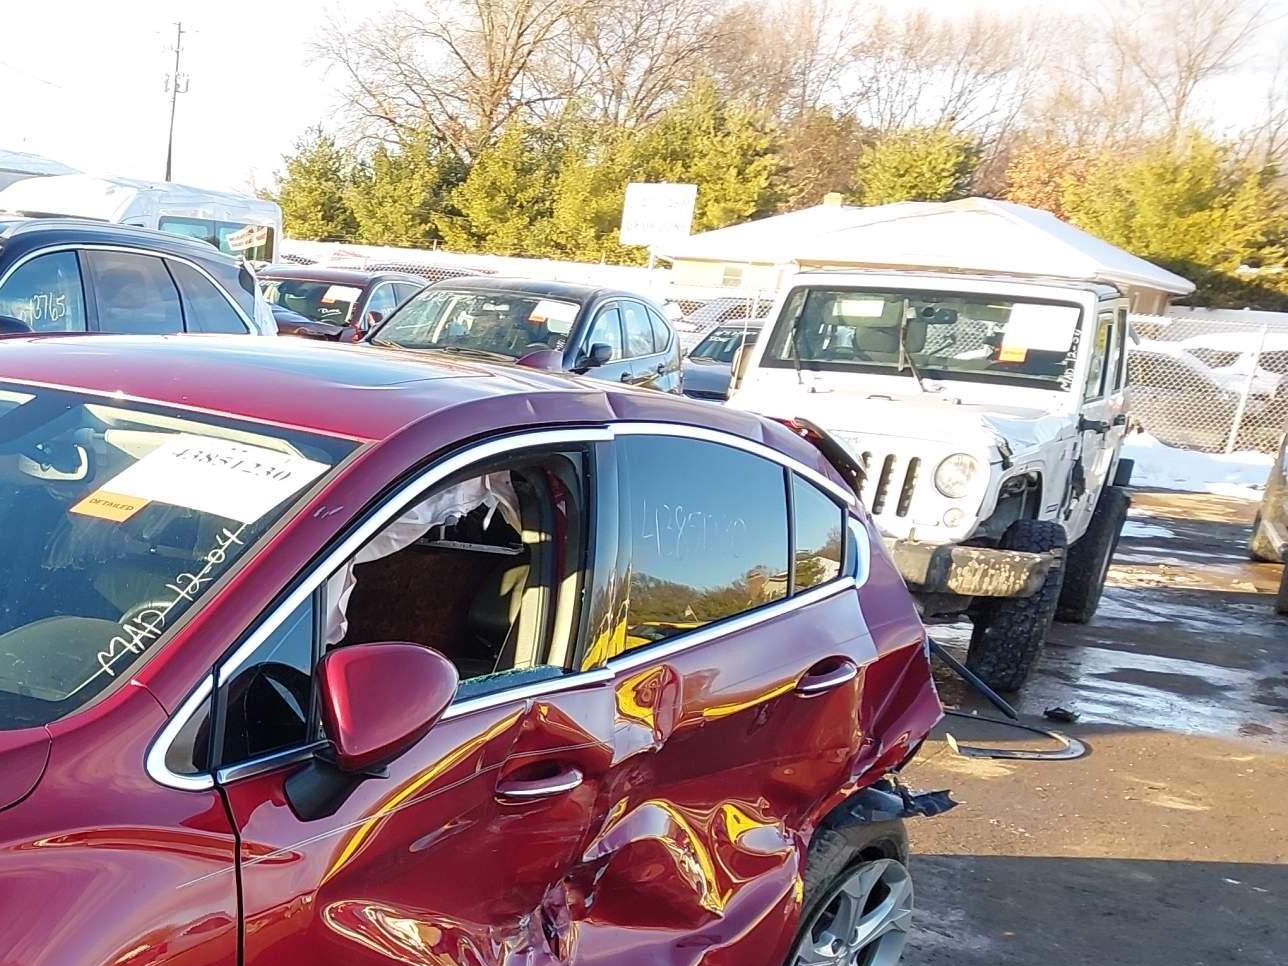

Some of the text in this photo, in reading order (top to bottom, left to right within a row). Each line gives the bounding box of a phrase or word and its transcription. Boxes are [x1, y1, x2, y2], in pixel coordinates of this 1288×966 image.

[89, 498, 134, 511] DETAILED
[97, 528, 245, 676] MAD 12-04
